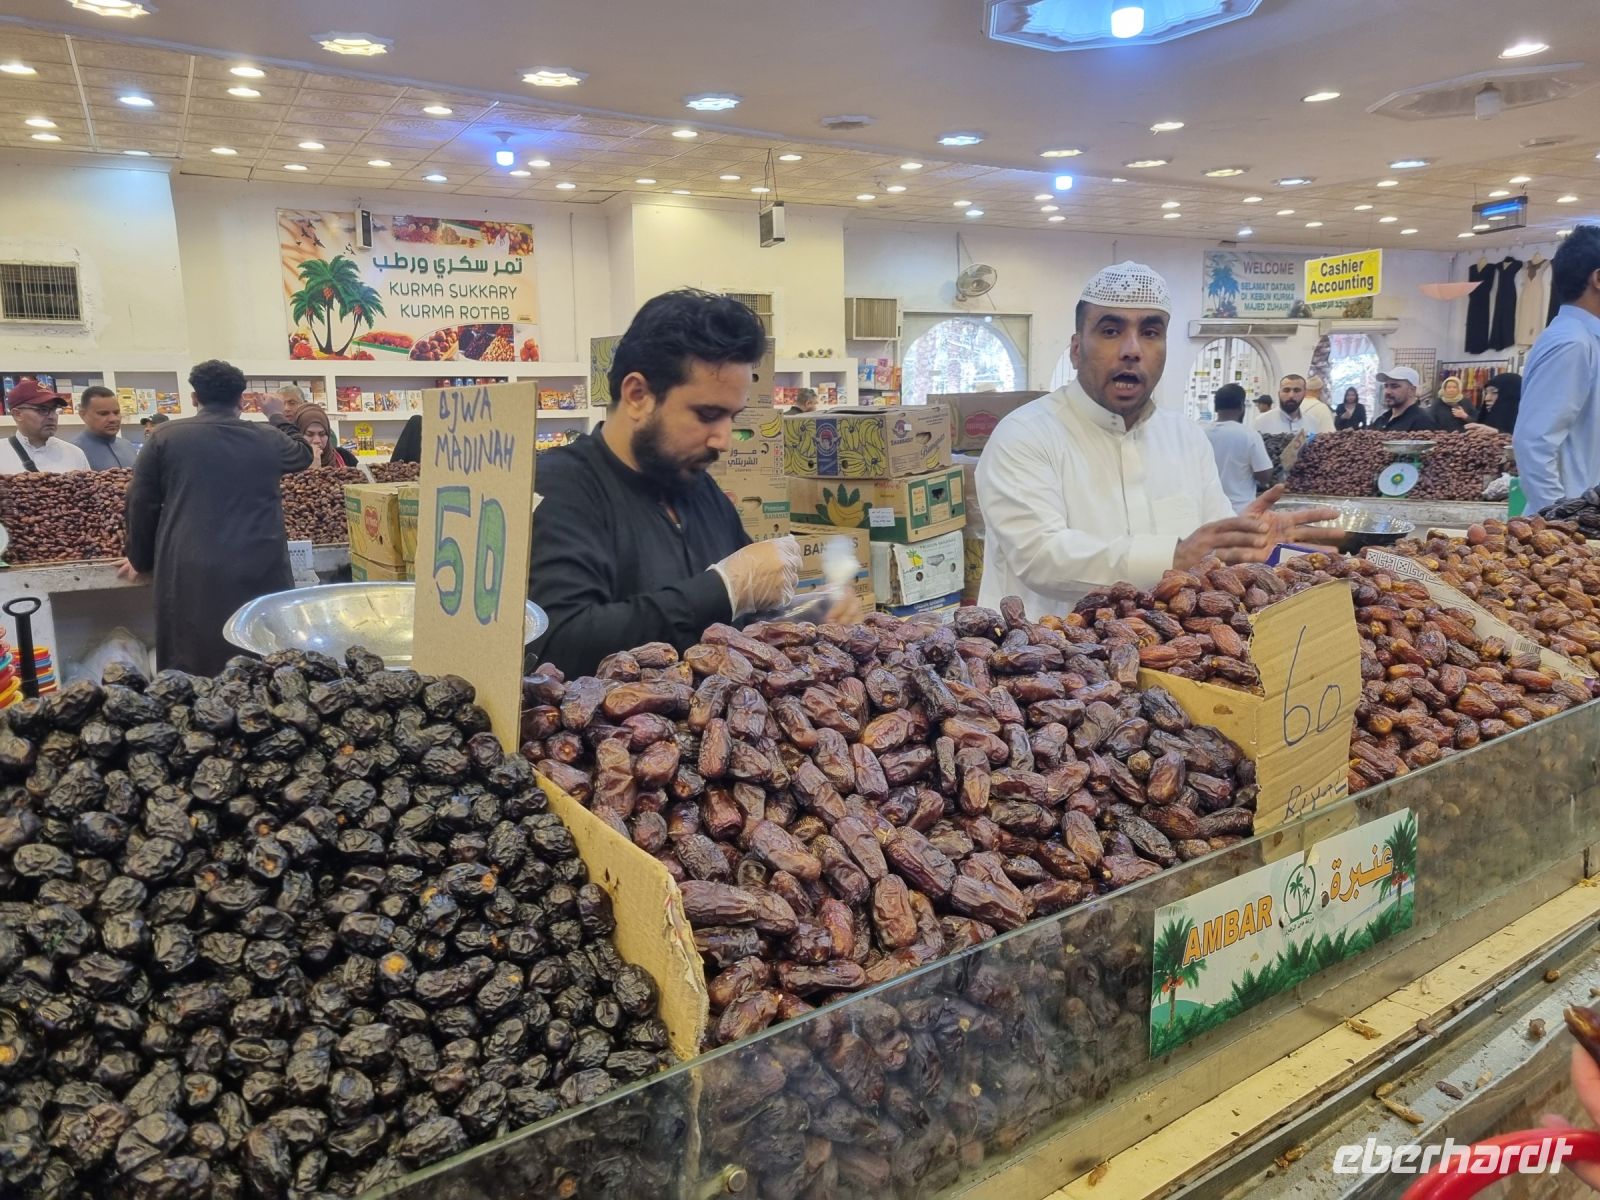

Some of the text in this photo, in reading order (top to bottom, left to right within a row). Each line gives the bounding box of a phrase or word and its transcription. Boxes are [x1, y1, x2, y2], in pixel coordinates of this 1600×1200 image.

[373, 252, 523, 278] تمر سكري ورطب
[1243, 261, 1294, 275] WELCOME
[1320, 258, 1363, 277] Cashier
[389, 281, 517, 299] KURMA SUKKARY
[1241, 282, 1295, 291] SELAMAT DATANG
[1310, 274, 1374, 295] Accounting
[1244, 302, 1265, 311] MAJED
[1250, 292, 1272, 301] KEBUN
[1273, 292, 1295, 301] KURMA
[400, 304, 454, 319] KURMA
[460, 306, 510, 320] ROTAB
[435, 429, 515, 475] MADINAH
[433, 485, 506, 625] 50
[1283, 625, 1343, 747] 60
[1330, 844, 1394, 903] عنبرة
[1182, 894, 1274, 966] AMBAR
